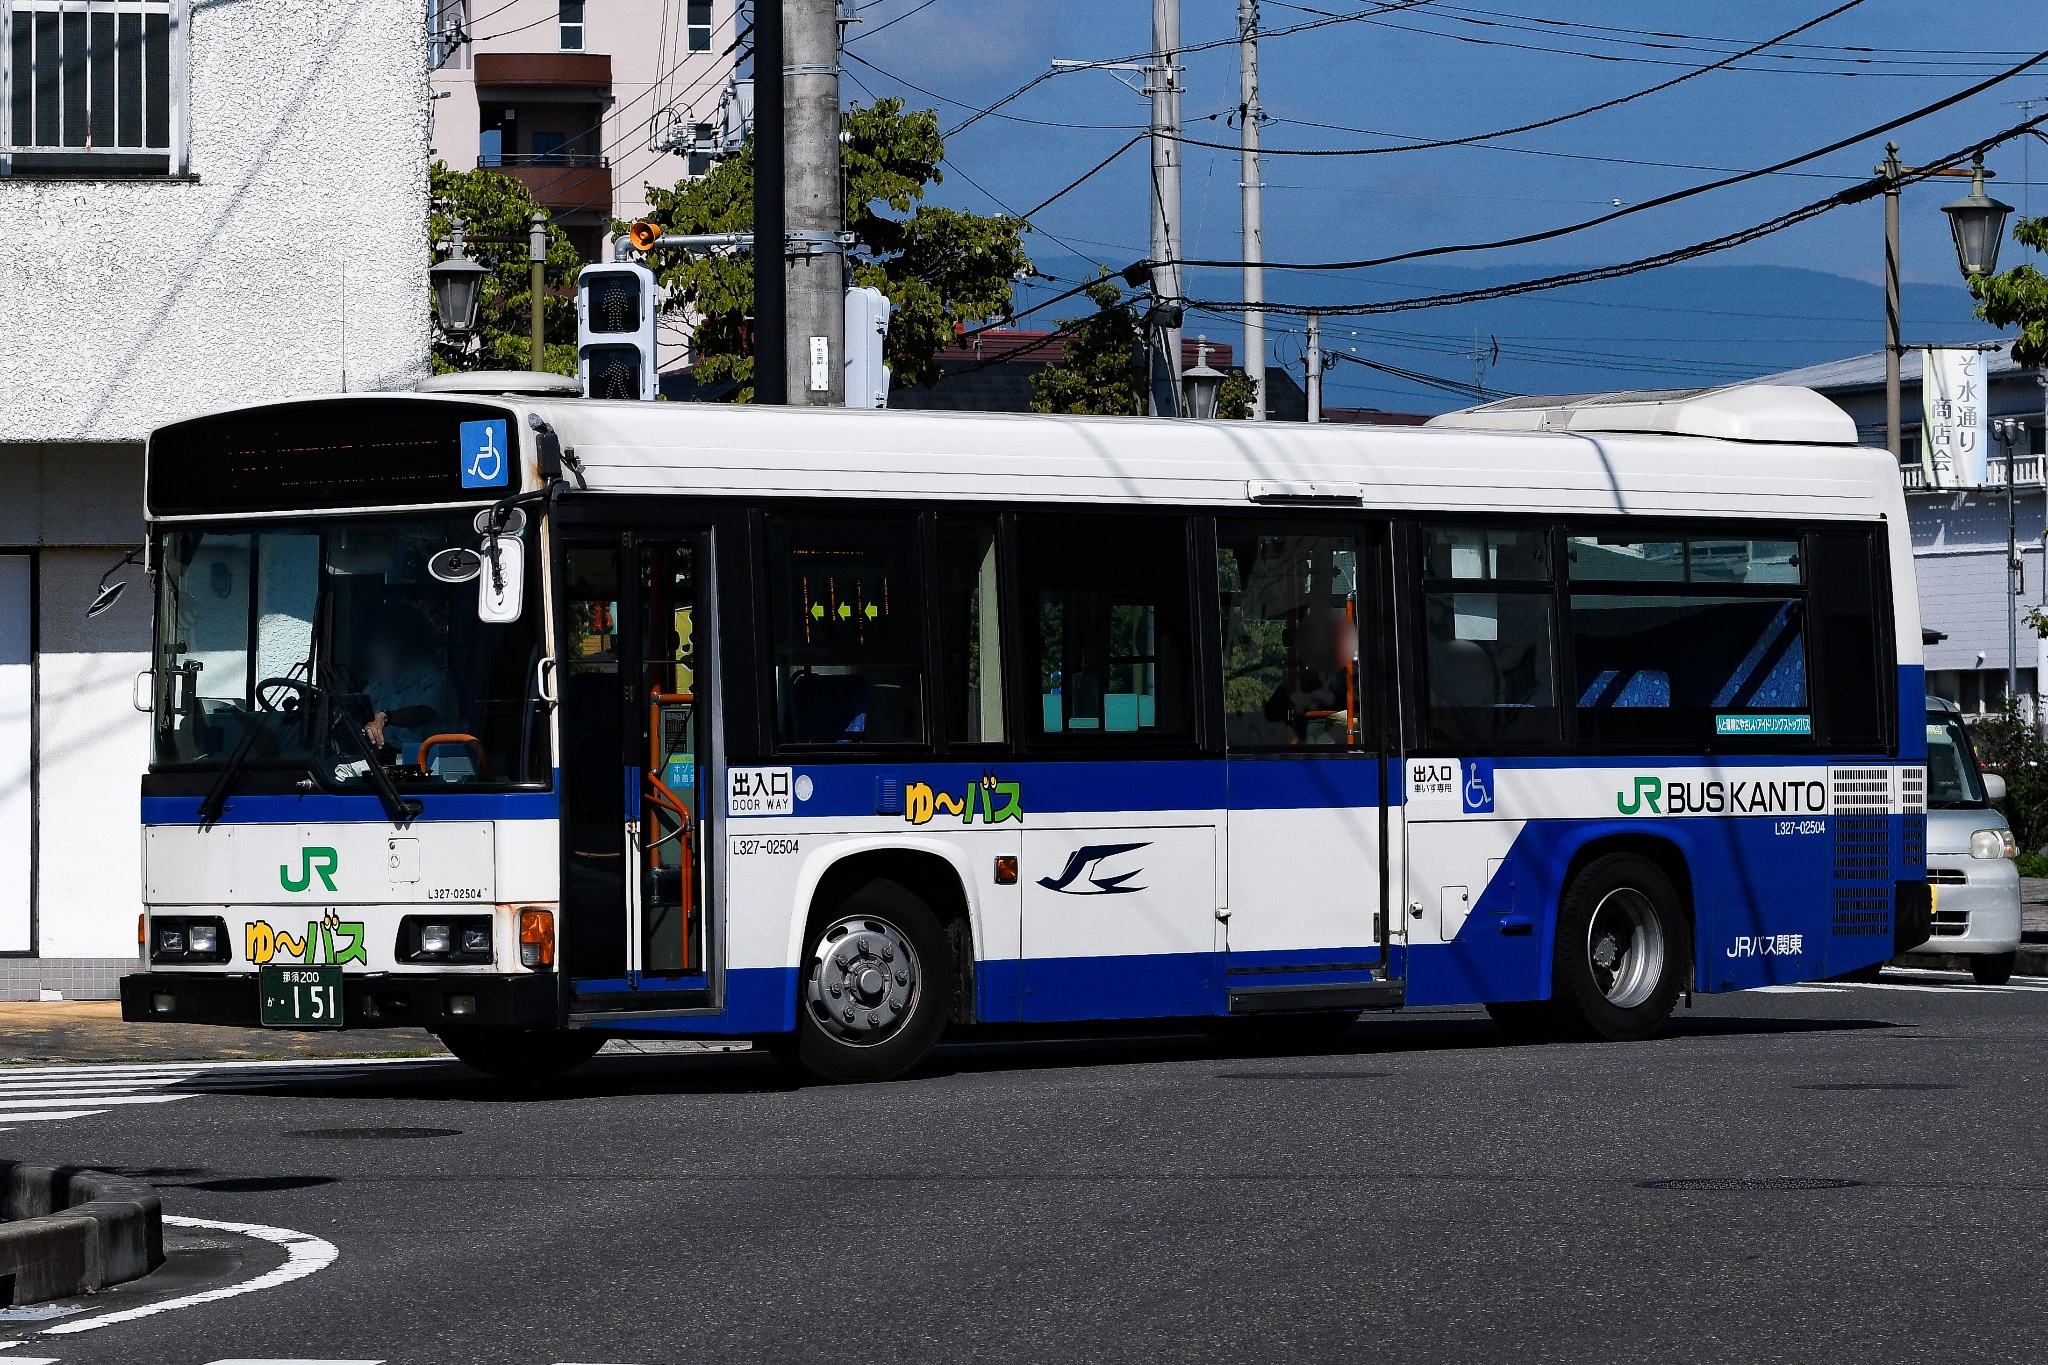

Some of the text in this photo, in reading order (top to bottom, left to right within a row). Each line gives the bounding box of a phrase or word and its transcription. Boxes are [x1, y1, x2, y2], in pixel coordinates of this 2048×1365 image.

[1956, 355, 1979, 453] そ水通り
[1930, 397, 1952, 472] 商店会
[1413, 765, 1452, 782] 出入口
[732, 772, 789, 797] 出入口
[1413, 783, 1452, 793] 車いす専用
[732, 798, 789, 811] DOOR WAY
[1617, 777, 1826, 815] JR BUS KANTO
[1774, 820, 1826, 835] L327-02504
[732, 839, 800, 855] L327-02504
[280, 847, 339, 892] JR
[428, 888, 482, 899] L327-02504
[1726, 933, 1803, 958] JRバス関東
